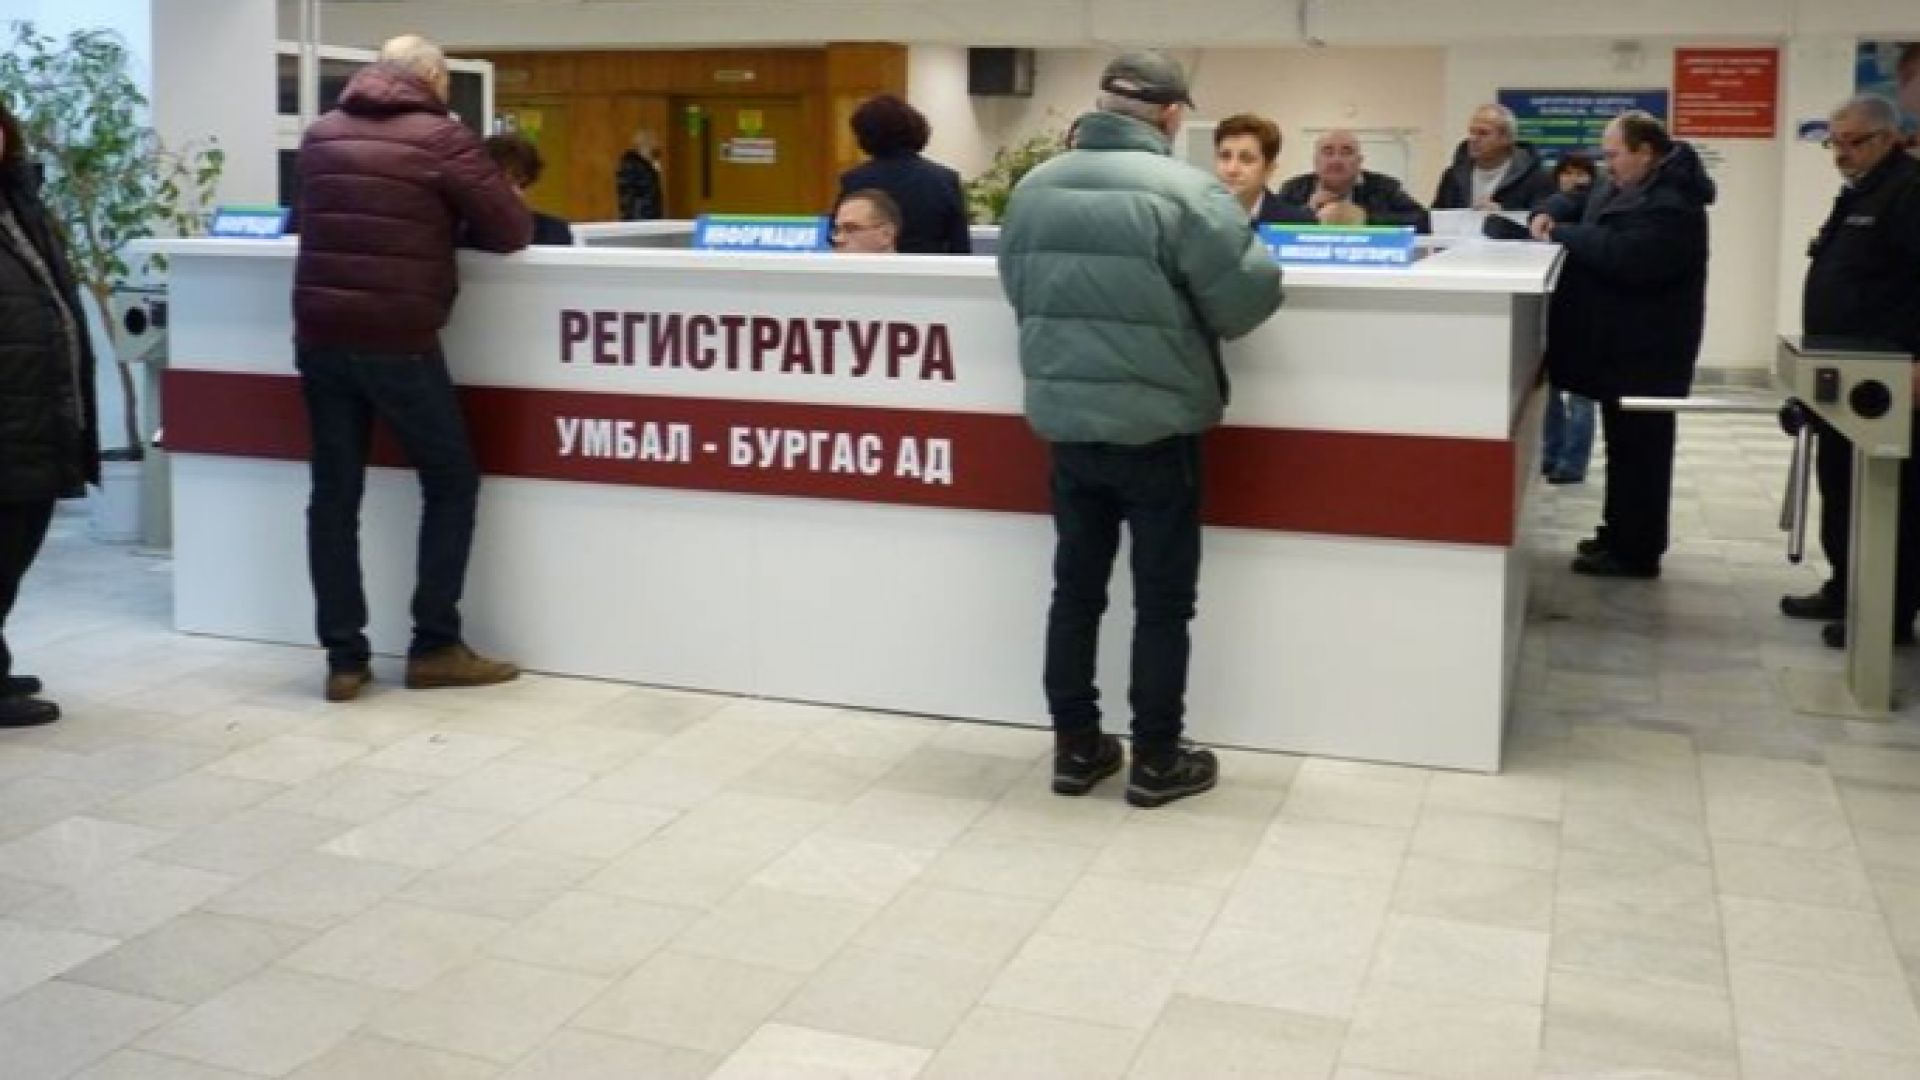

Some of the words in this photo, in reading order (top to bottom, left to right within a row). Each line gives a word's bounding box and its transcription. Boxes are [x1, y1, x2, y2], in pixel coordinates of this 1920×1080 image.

[560, 310, 956, 380] РЕГИСТРАТУРА
[556, 416, 692, 463] УМБАЛ
[702, 443, 718, 453] -
[728, 427, 883, 475] БУРГАС
[895, 437, 953, 484] АД
